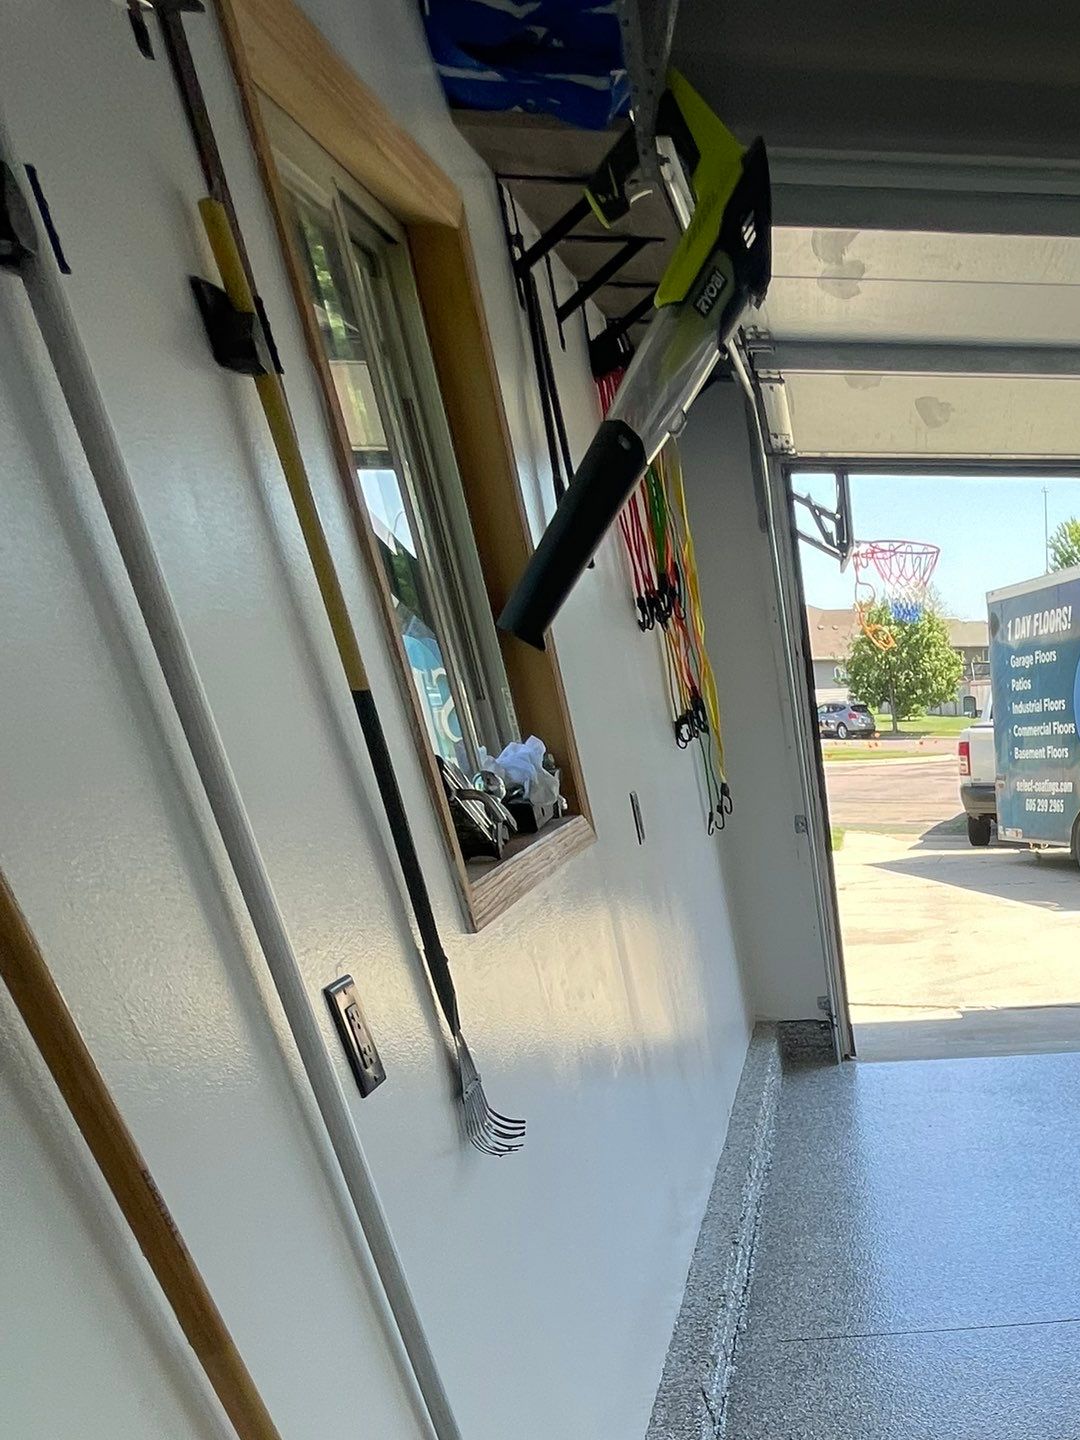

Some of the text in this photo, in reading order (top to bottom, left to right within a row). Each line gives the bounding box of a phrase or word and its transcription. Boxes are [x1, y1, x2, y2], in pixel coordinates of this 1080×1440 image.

[696, 270, 726, 314] RYOBI
[1007, 605, 1072, 641] 1 DAY FLOORS!
[1010, 650, 1057, 668] Garage Floors
[1011, 677, 1032, 692] Patios
[1012, 698, 1066, 714] Industrial Floors
[1013, 721, 1076, 737] Commercial Floors
[1014, 745, 1069, 760] Basement Floors
[1016, 779, 1073, 795] select-coatings.com
